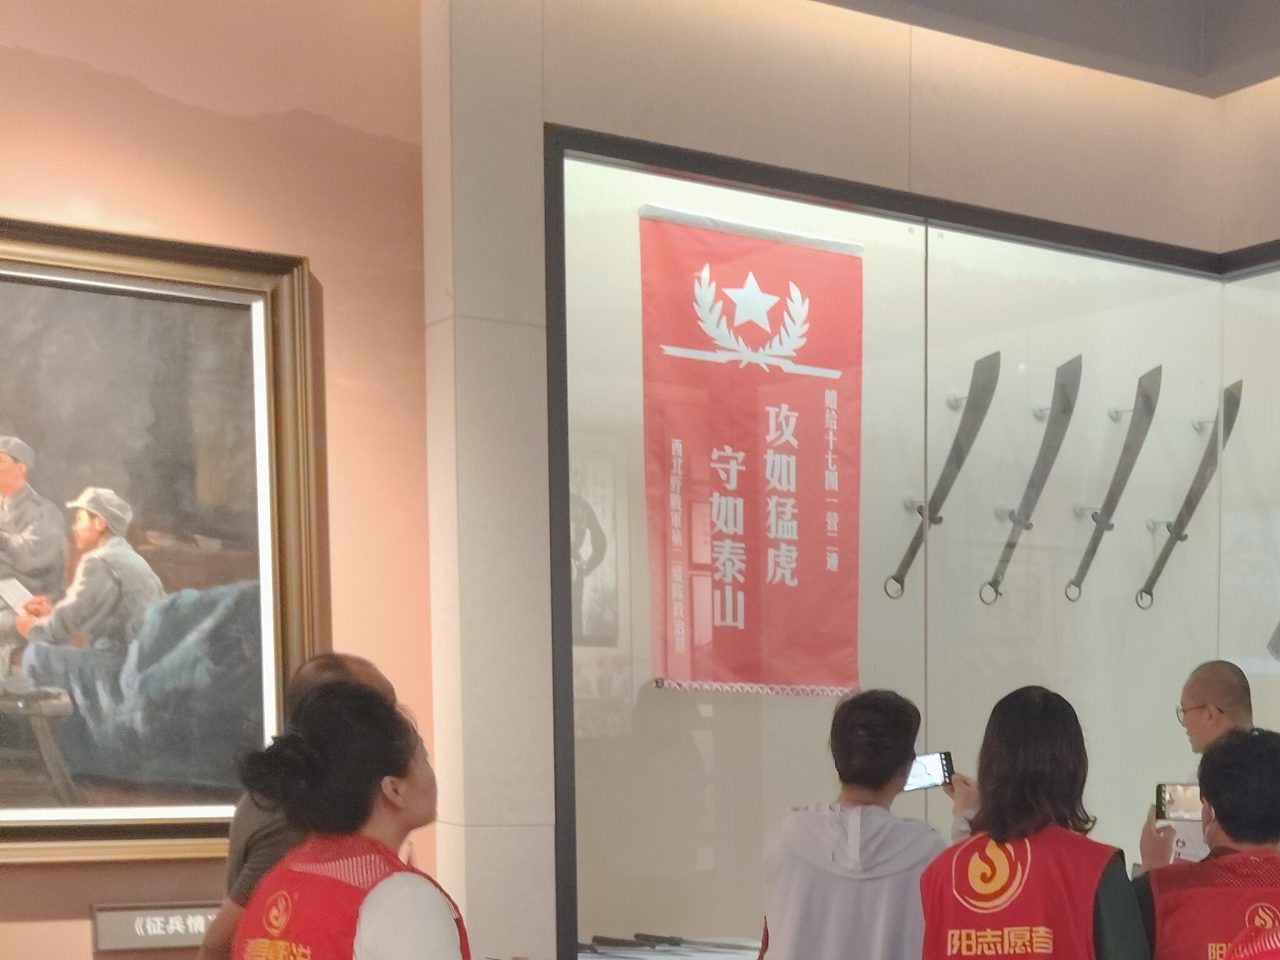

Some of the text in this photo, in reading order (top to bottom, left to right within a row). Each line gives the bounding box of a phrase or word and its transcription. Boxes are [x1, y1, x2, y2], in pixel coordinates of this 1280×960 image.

[709, 444, 747, 631] 守如泰山
[763, 403, 799, 587] 攻如猛虎
[134, 914, 216, 937] 《征兵情
[946, 926, 1054, 957] 阳志愿者
